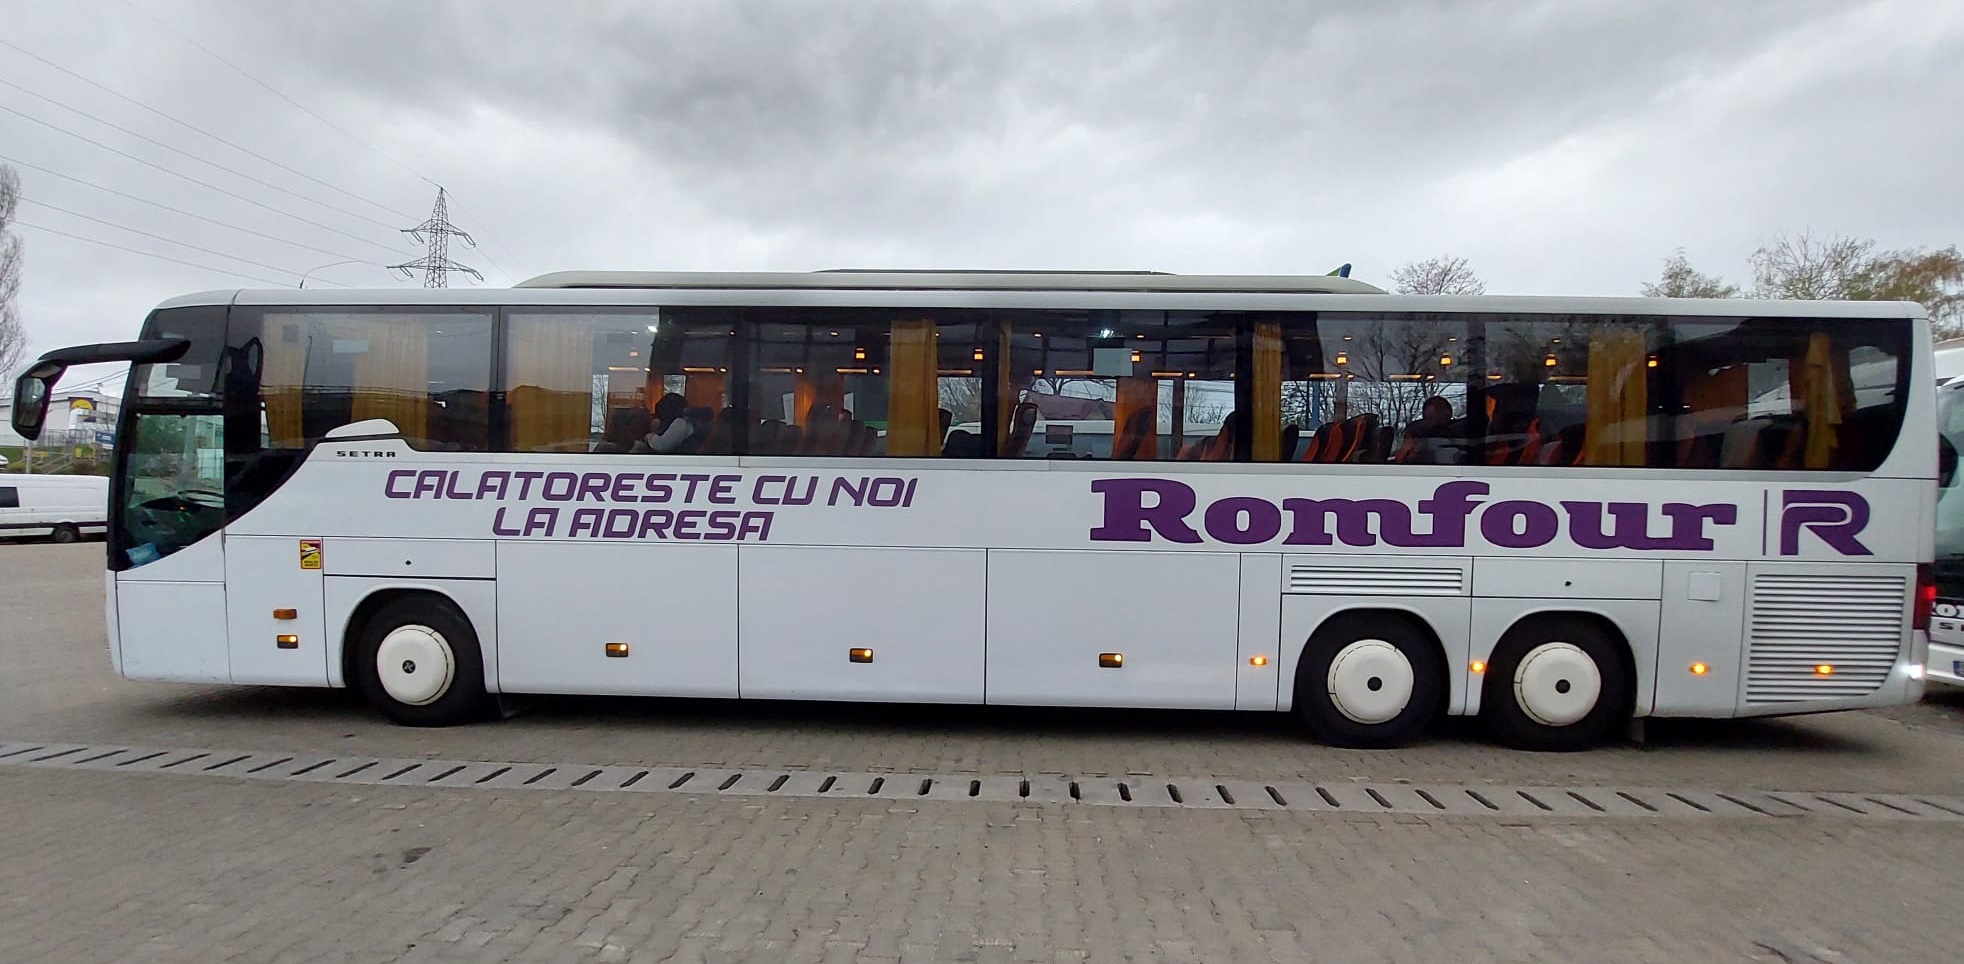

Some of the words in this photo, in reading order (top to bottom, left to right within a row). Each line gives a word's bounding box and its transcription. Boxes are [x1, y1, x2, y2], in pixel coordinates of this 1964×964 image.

[336, 450, 396, 458] SETRA
[385, 469, 741, 503] CALATORESTE
[751, 475, 818, 505] CU
[827, 477, 918, 508] NOI
[492, 507, 558, 537] LA
[568, 508, 774, 541] ADRESA
[1090, 478, 1737, 550] Romfour
[1780, 489, 1875, 556] R
